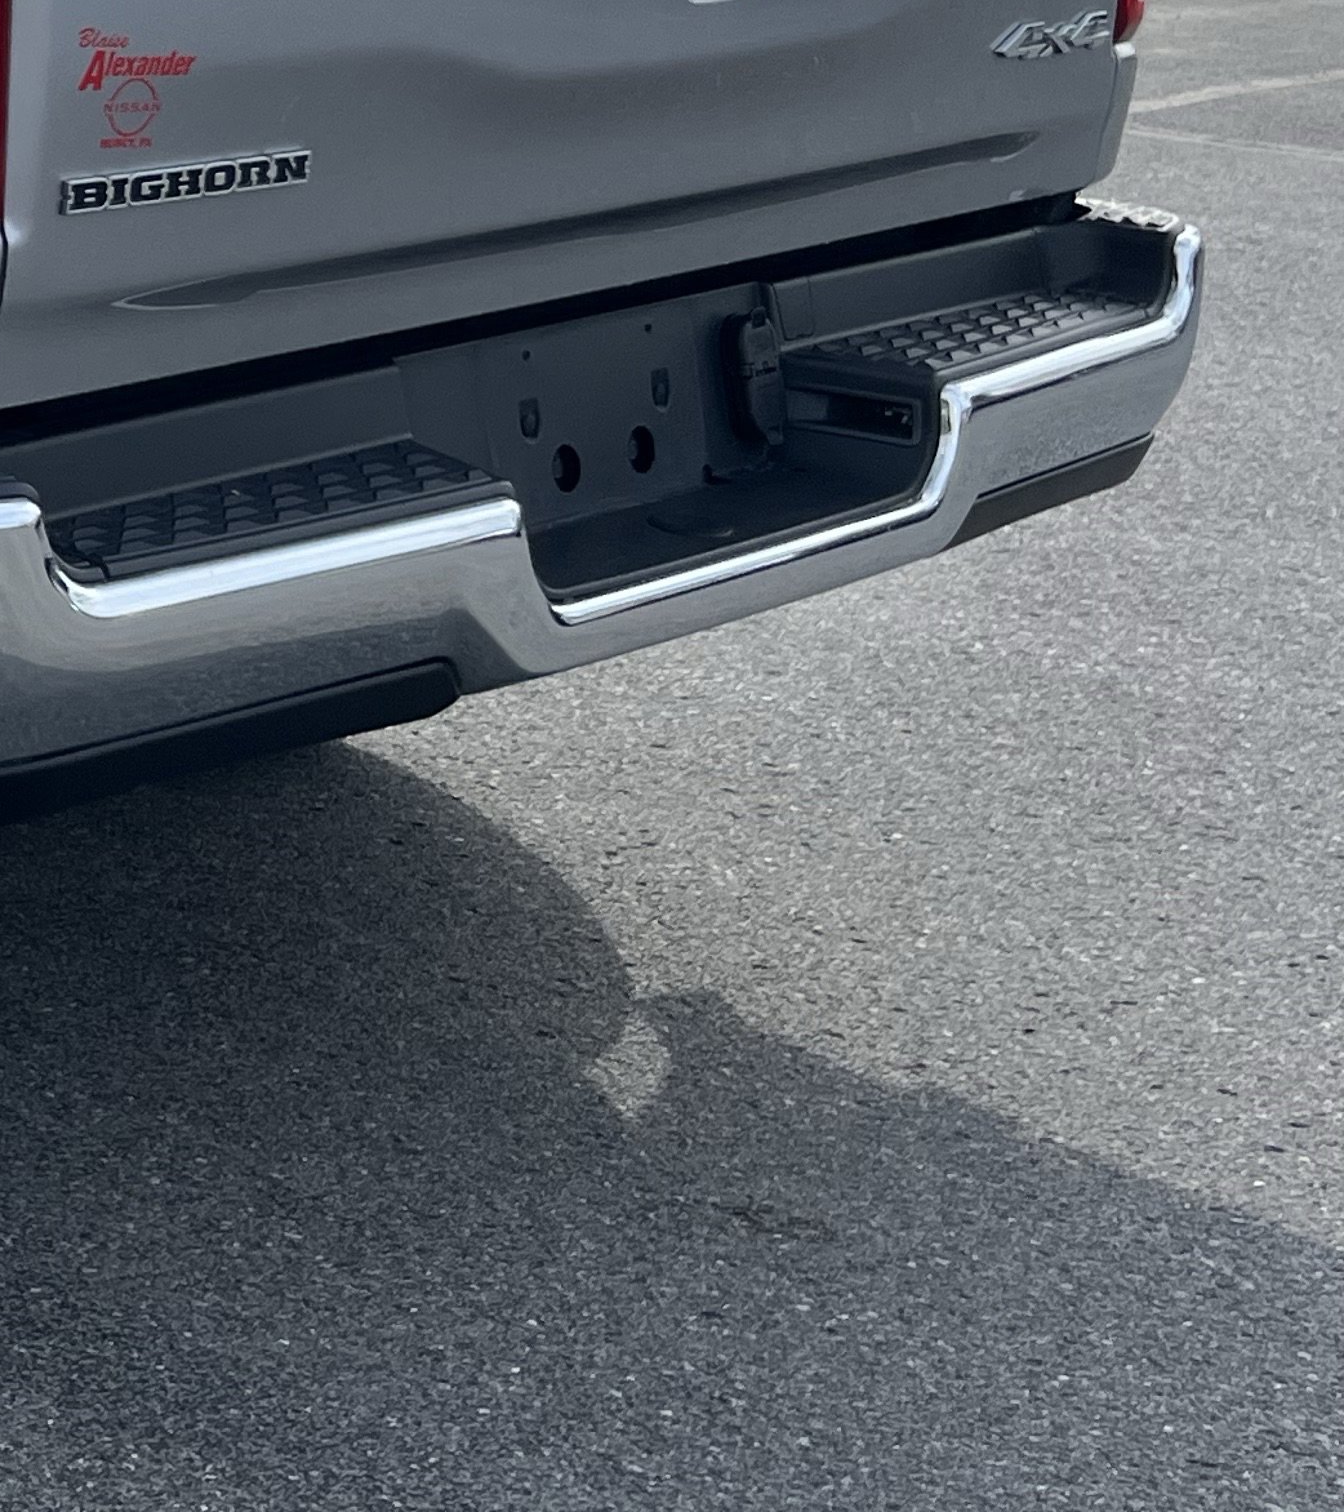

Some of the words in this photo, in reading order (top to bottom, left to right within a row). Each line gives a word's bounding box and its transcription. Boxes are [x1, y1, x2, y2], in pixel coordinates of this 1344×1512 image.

[78, 49, 197, 91] Alexander
[103, 101, 161, 114] NISSAN
[65, 152, 311, 214] BIGHORN
